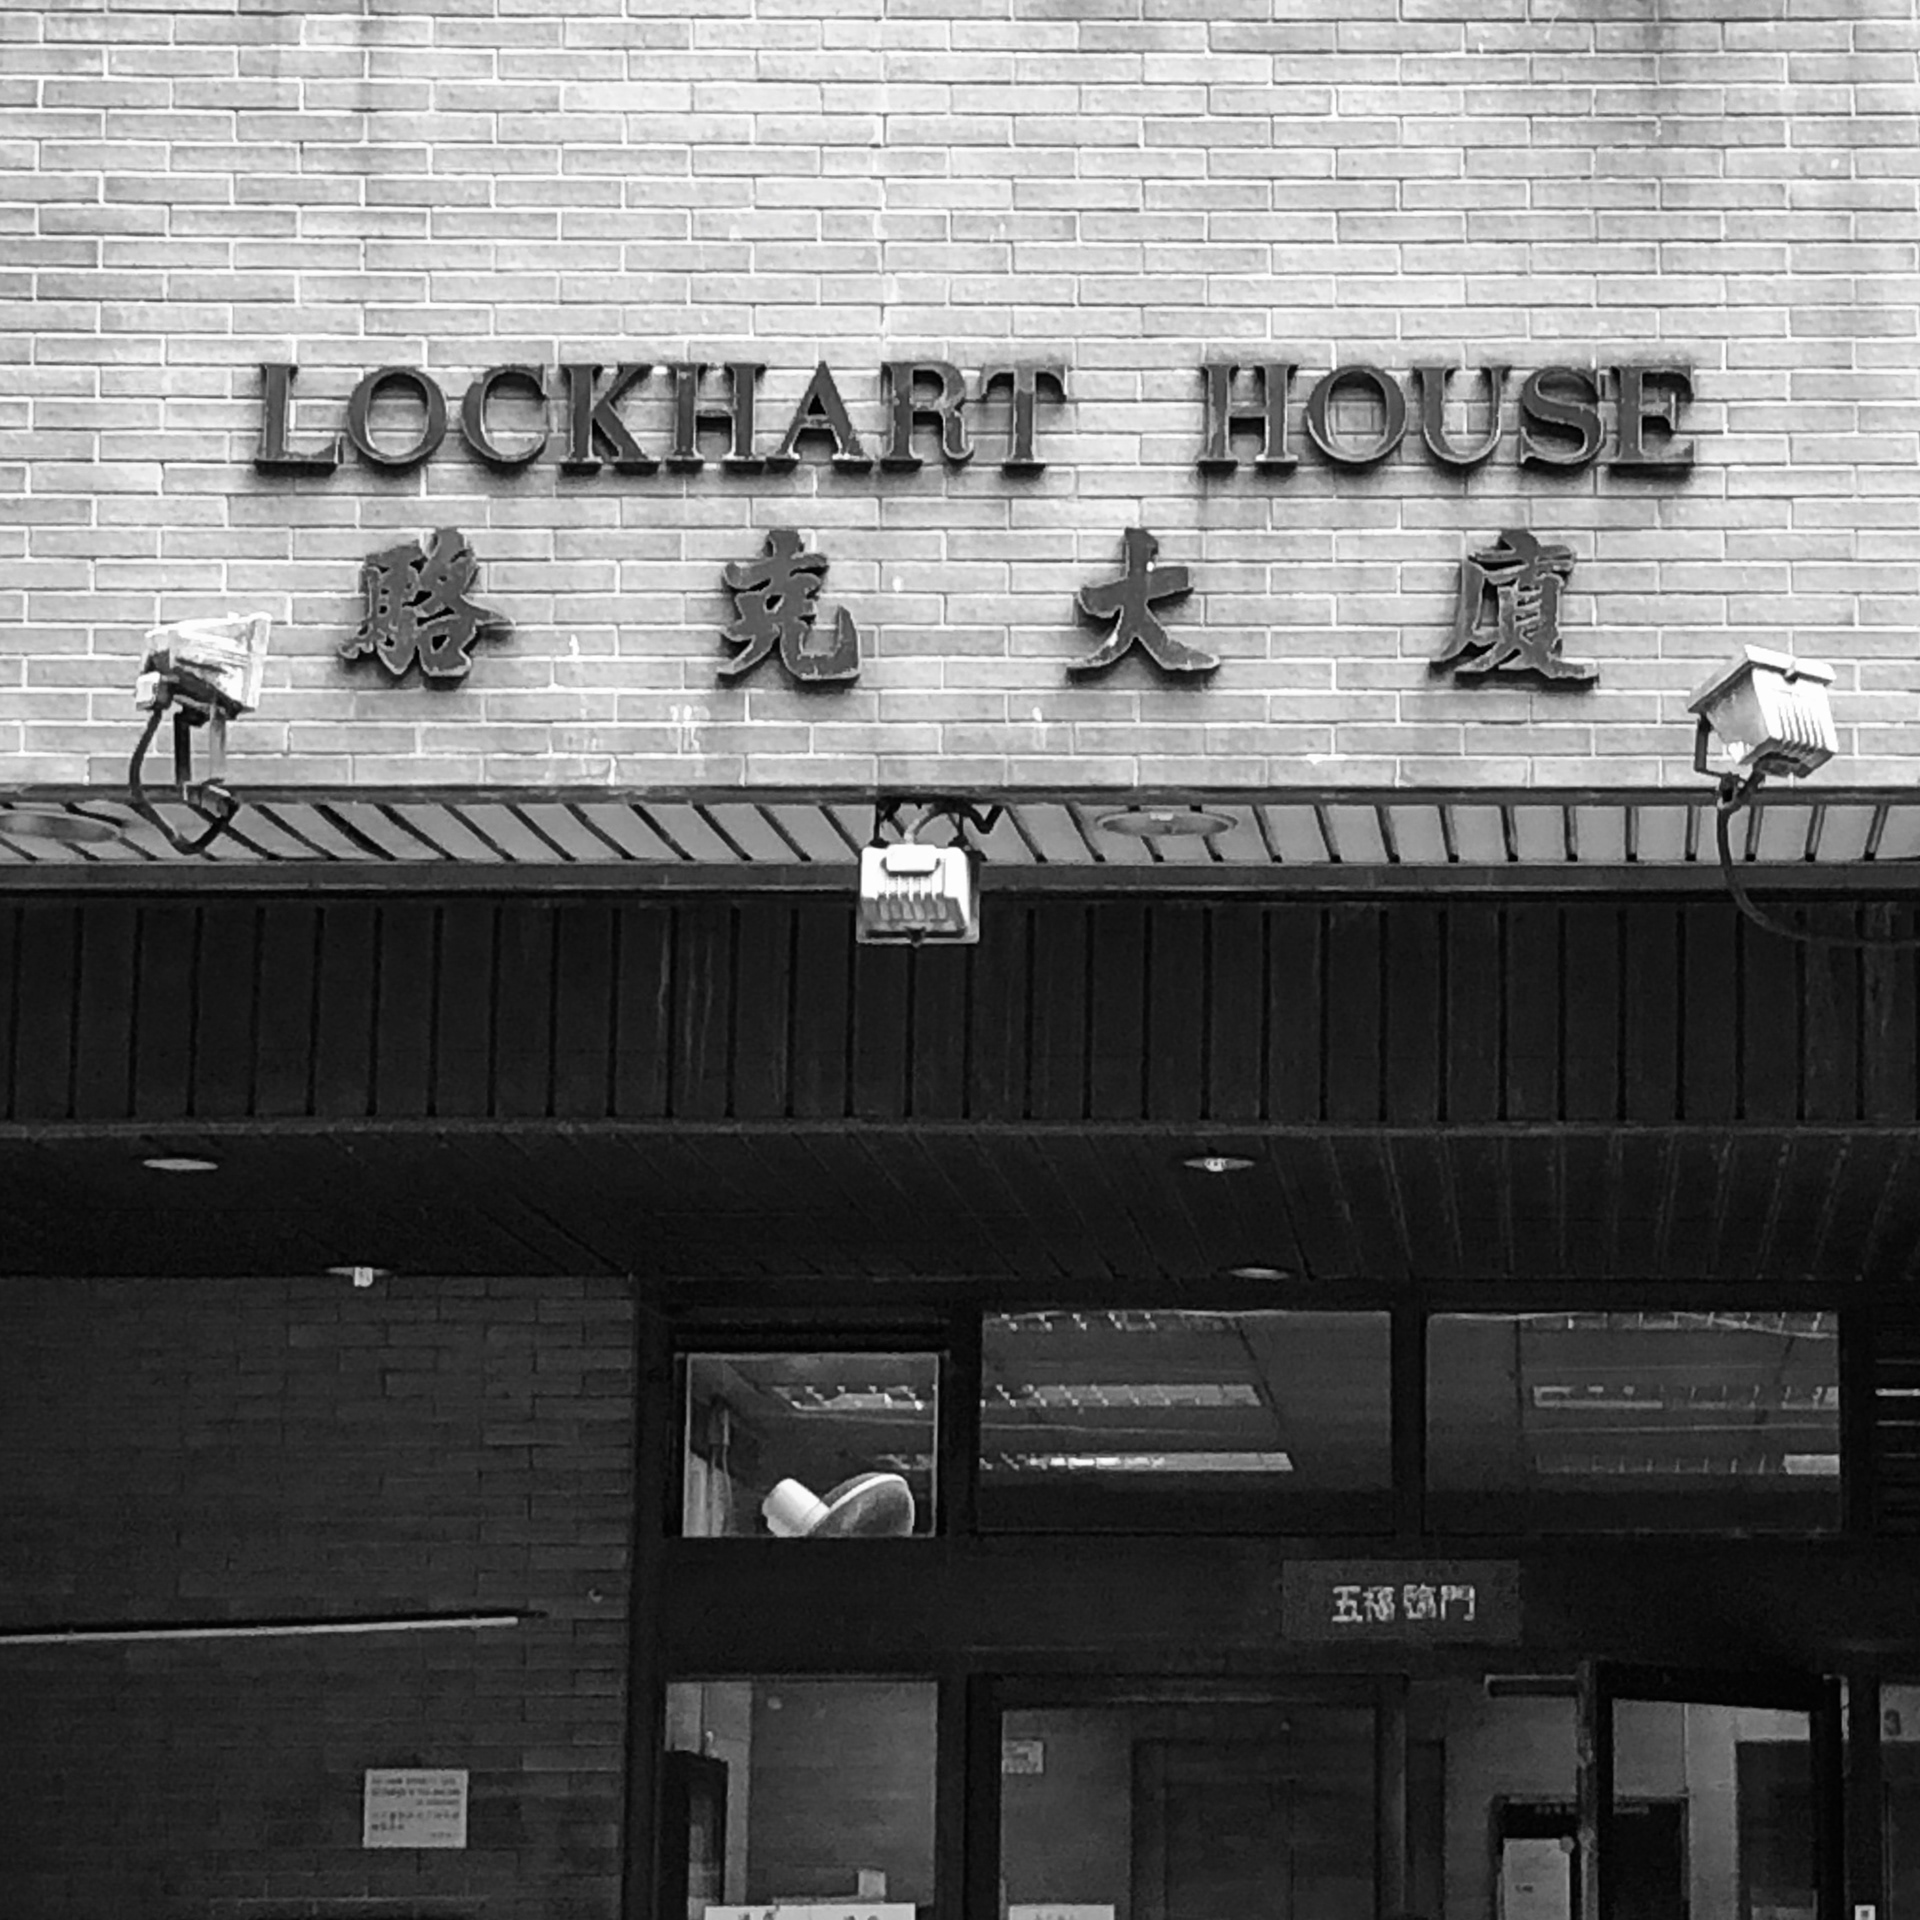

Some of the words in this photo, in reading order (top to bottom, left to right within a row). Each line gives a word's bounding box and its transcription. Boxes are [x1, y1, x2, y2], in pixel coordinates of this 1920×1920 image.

[256, 361, 1068, 472] LOCKHART
[1202, 364, 1695, 472] HOUSE
[339, 527, 1598, 683] 駱克大廈
